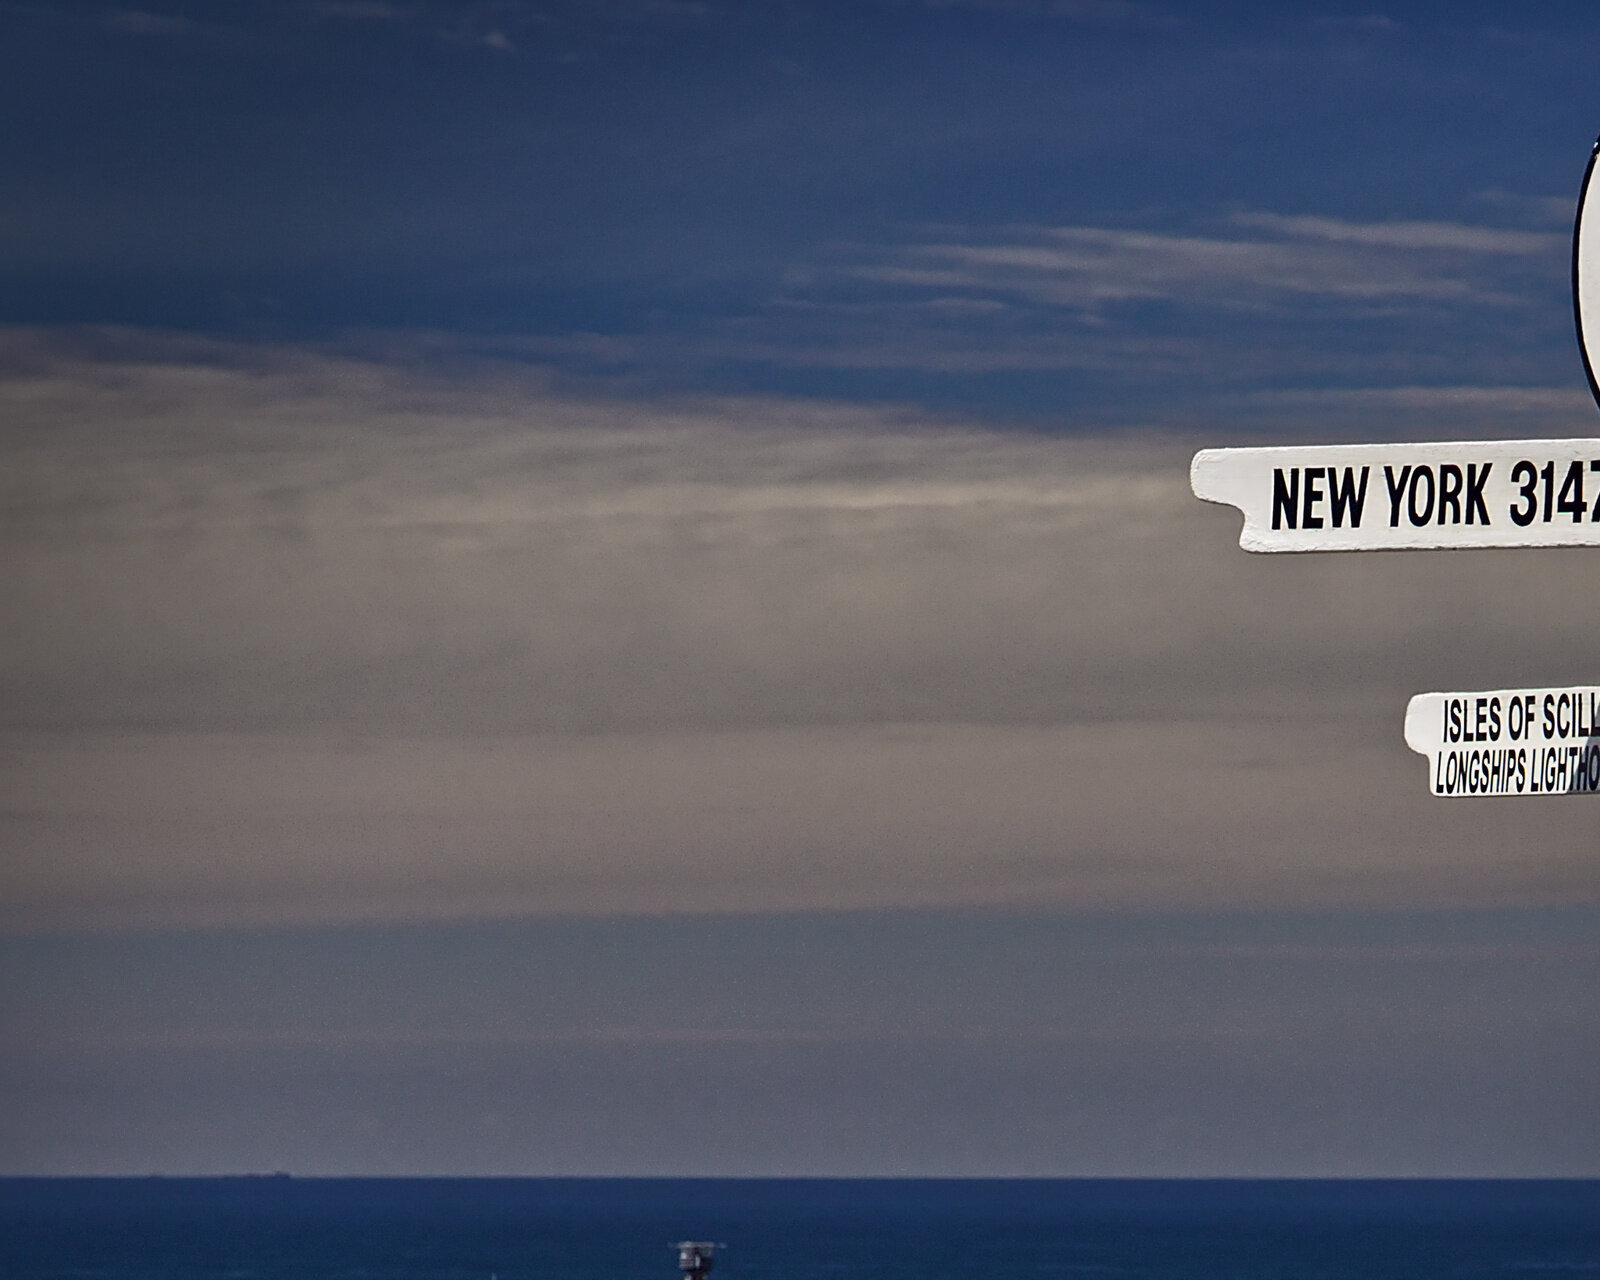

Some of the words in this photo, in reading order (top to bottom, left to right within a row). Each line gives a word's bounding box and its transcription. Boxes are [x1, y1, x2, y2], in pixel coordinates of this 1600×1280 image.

[1271, 466, 1370, 530] NEW
[1384, 462, 1493, 528] YORK
[1443, 697, 1501, 743] ISLES
[1508, 695, 1536, 741] OF
[1436, 748, 1527, 794] LONGSHIPS
